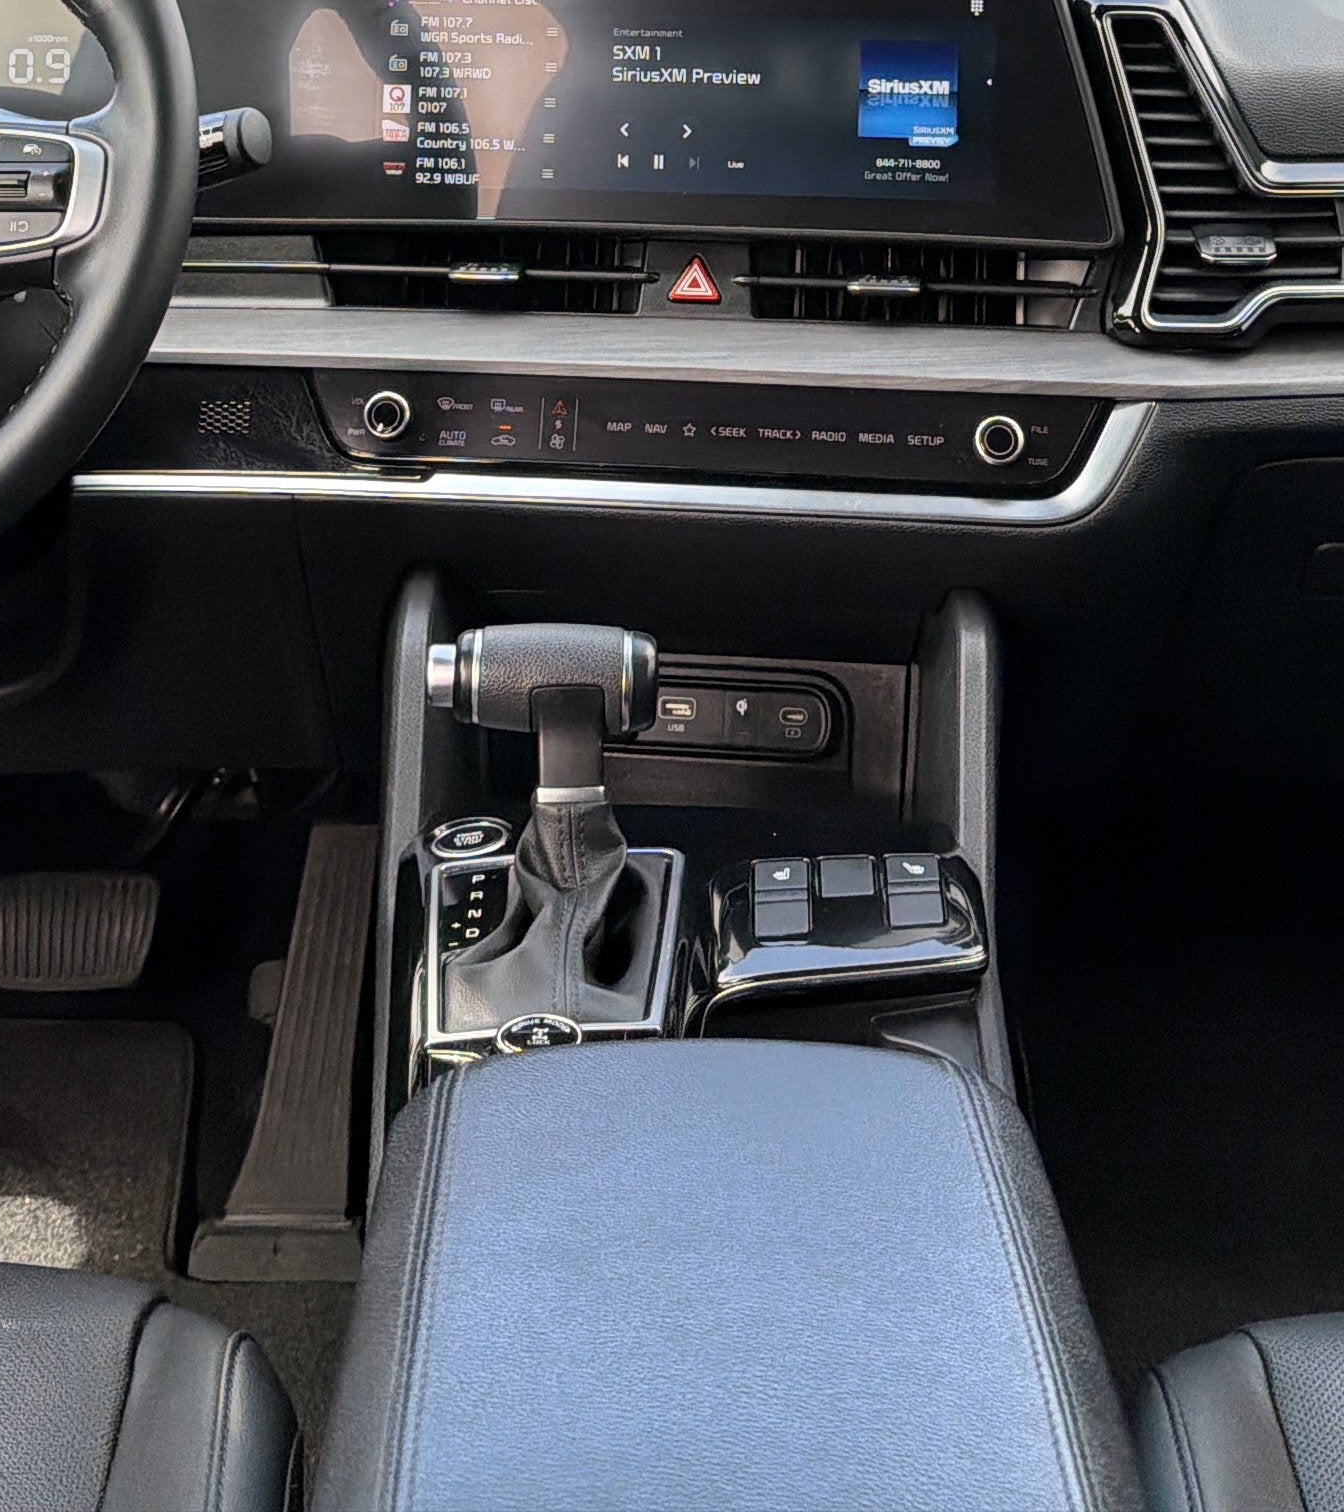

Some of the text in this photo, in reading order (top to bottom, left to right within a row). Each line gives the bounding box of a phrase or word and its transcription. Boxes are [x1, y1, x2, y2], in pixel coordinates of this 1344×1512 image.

[420, 16, 473, 28] FM 107.7
[420, 31, 534, 45] WGR Sports Radi...
[612, 27, 684, 39] Entertainment
[419, 51, 472, 64] FM 107.3
[612, 45, 662, 61] SXM 1
[8, 48, 71, 84] 0.9
[419, 66, 492, 80] 107.3 WRWD
[612, 66, 761, 85] SiriusXM Preview
[418, 86, 468, 99] FM 107.1
[867, 78, 950, 95] SiriusXM
[389, 86, 406, 103] Q
[389, 102, 406, 112] 107
[418, 101, 447, 114] Q107
[417, 121, 470, 134] FM 106.5
[416, 136, 467, 151] Country
[469, 138, 501, 150] 106.5
[416, 157, 435, 169] FM
[437, 158, 466, 170] 106.1
[875, 158, 941, 169] 844-711-8800
[415, 172, 481, 185] 92.9 WBUF
[864, 170, 950, 183] Great Offer Now!
[606, 421, 632, 432] MAP
[644, 423, 668, 434] NAV
[1030, 426, 1049, 435] FILE
[439, 430, 467, 440] AUTO
[718, 427, 794, 439] SEEK TRACK
[811, 430, 847, 442] RADIO
[858, 432, 895, 444] MEDIA
[907, 434, 945, 446] SETUP
[667, 723, 685, 733] USB
[472, 874, 485, 884] P
[470, 890, 484, 901] R
[467, 908, 482, 919] N
[465, 927, 480, 939] D
